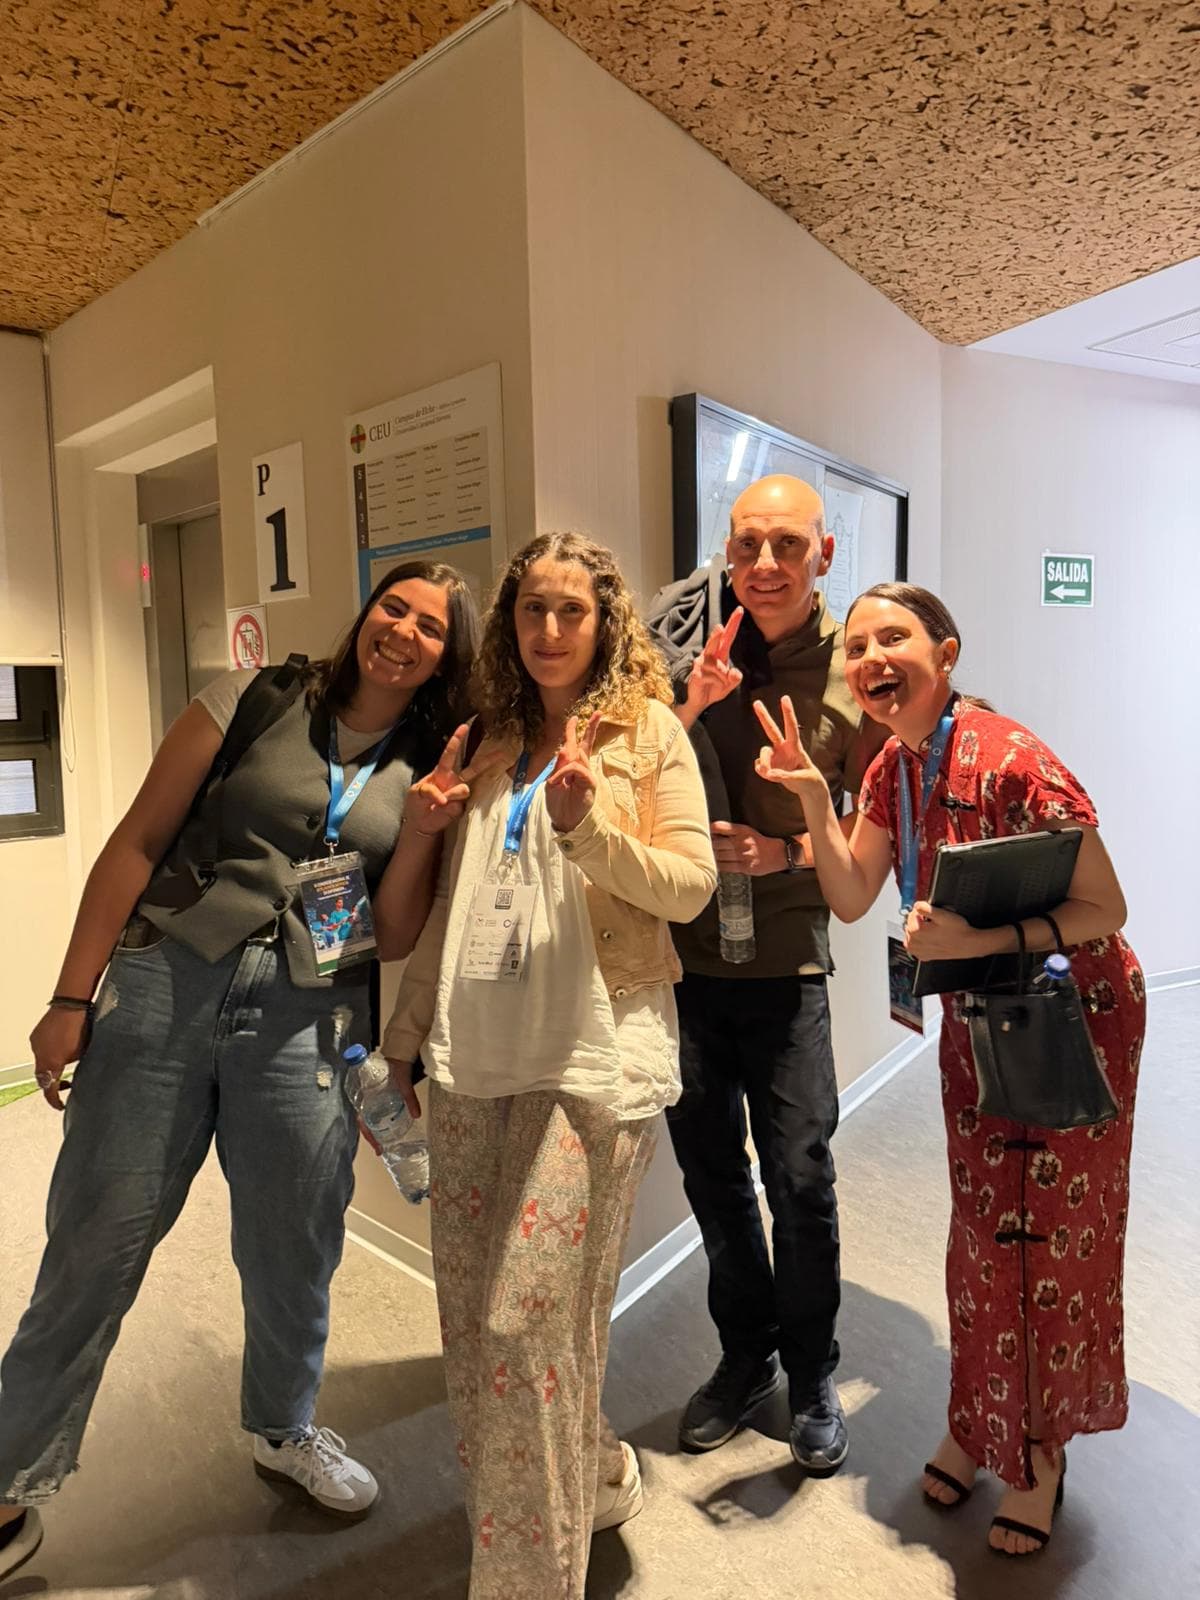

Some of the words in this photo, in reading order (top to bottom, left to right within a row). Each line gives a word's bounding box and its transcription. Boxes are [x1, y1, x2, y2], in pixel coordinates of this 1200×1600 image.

[369, 422, 391, 442] CEU
[257, 463, 270, 496] P
[266, 507, 296, 592] 1
[1047, 561, 1089, 582] SALIDA
